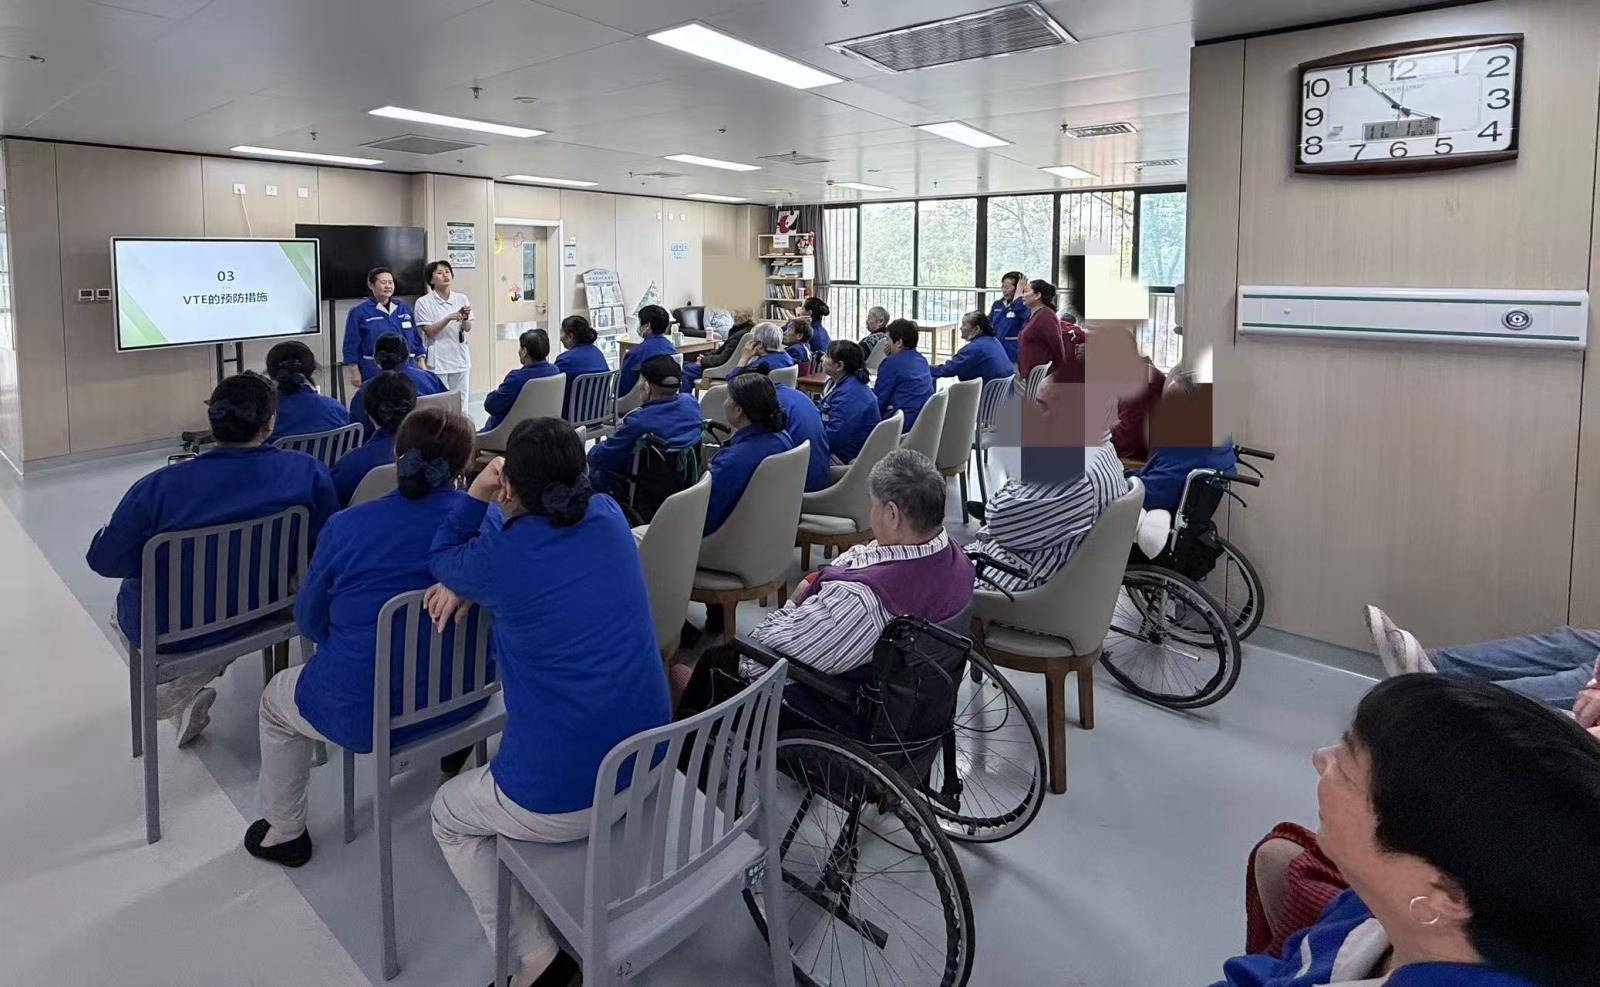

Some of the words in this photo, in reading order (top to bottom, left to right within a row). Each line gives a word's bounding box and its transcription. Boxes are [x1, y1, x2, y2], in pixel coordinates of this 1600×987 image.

[1346, 64, 1368, 86] 11
[1388, 59, 1418, 82] 12
[1486, 55, 1511, 78] 2
[1303, 78, 1330, 99] 10
[1487, 88, 1511, 110] 3
[1304, 107, 1324, 127] 9
[1477, 120, 1503, 142] 4
[1304, 135, 1324, 155] 8
[1349, 144, 1366, 160] 7
[1389, 141, 1408, 158] 6
[1434, 137, 1454, 155] 5
[217, 270, 235, 282] 03
[183, 291, 268, 305] VTE的预防措施
